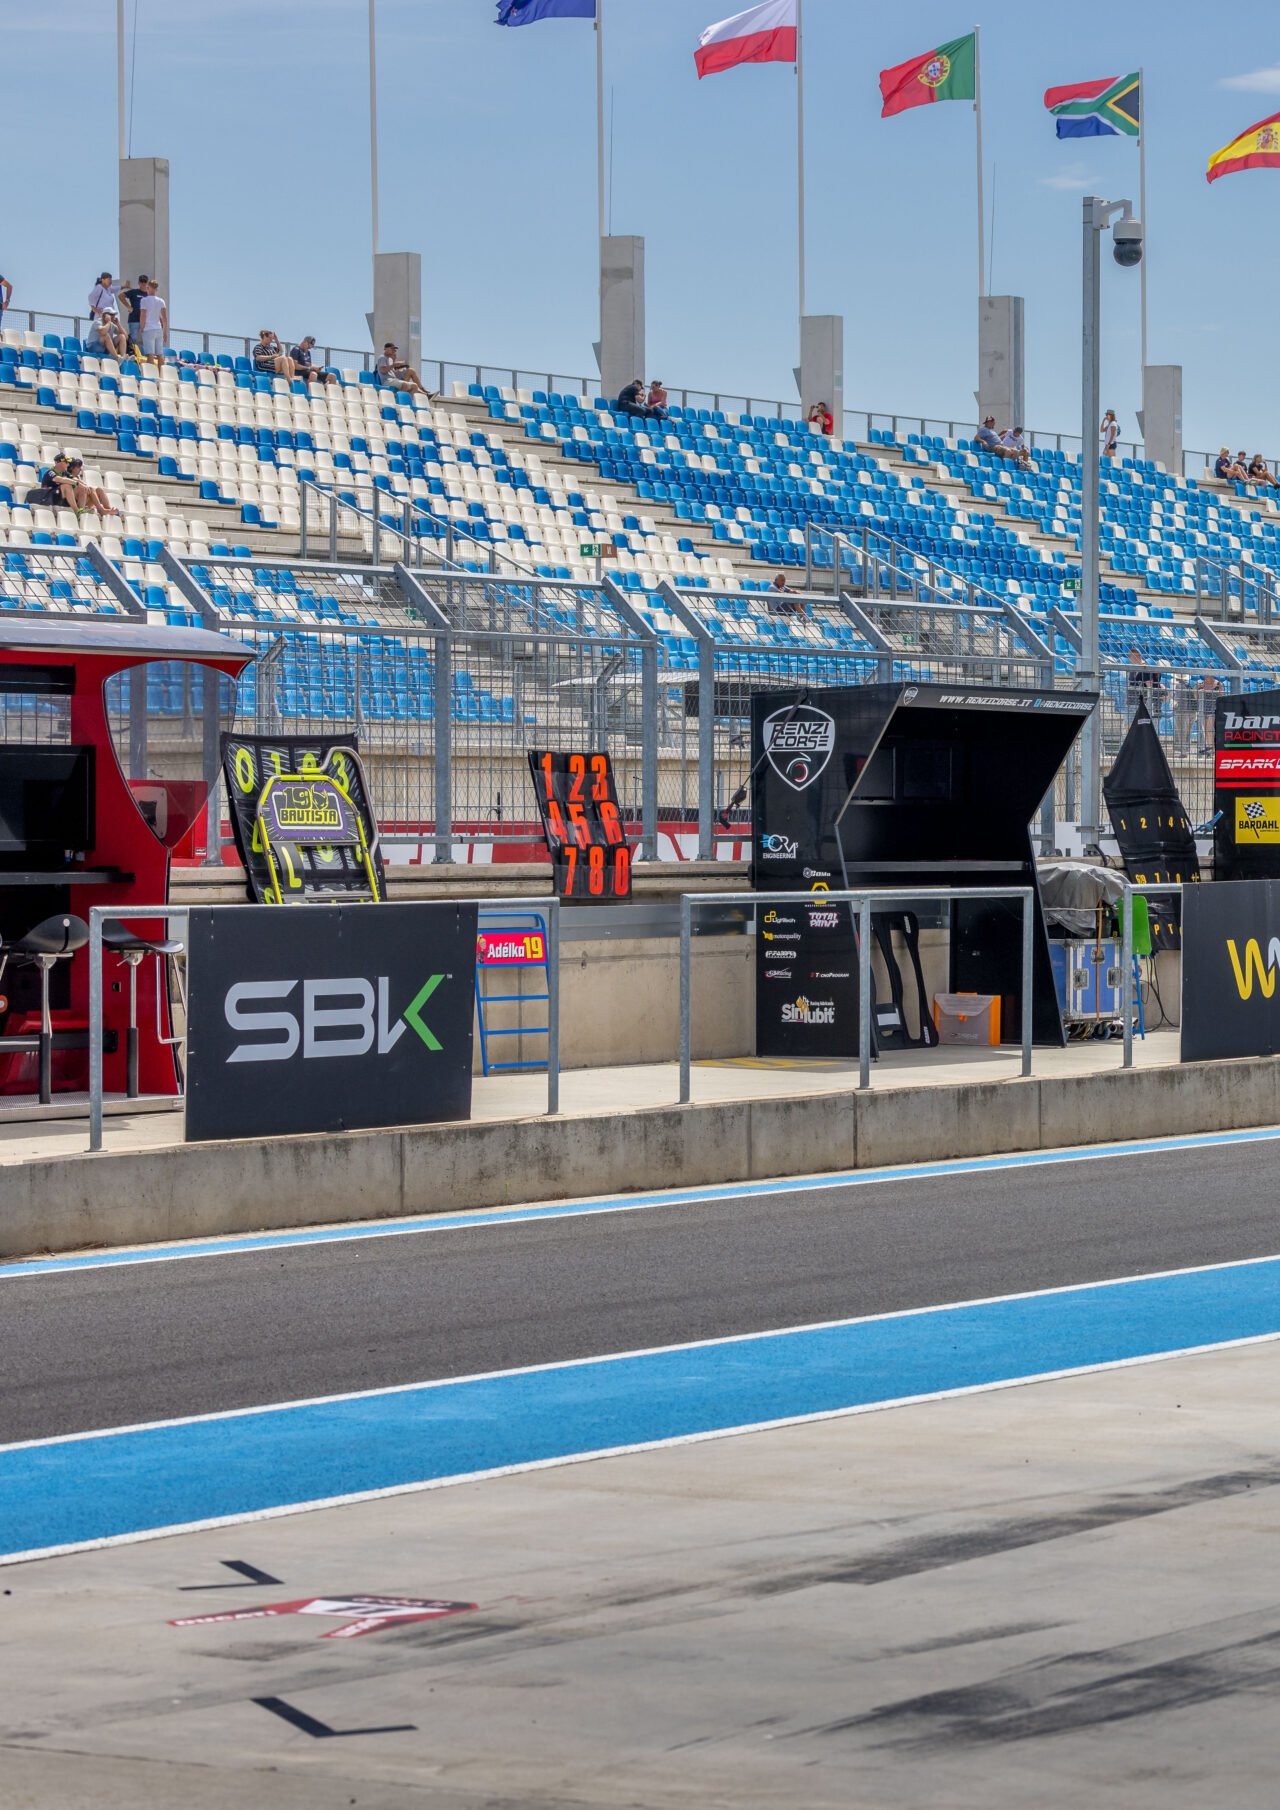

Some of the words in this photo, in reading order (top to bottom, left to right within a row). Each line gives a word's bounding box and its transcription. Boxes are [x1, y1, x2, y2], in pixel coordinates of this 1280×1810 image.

[771, 723, 829, 735] RENZI
[772, 735, 829, 750] CORSE
[1219, 758, 1276, 769] SPARK
[541, 753, 553, 799] 1
[569, 755, 585, 801] 2
[591, 755, 608, 800] 3
[279, 809, 338, 824] BAUTISTA
[1140, 817, 1147, 829] 2
[548, 801, 568, 844] 4
[568, 804, 592, 850] 5
[600, 802, 623, 844] 6
[1239, 820, 1279, 830] BARDAHL
[564, 847, 577, 895] 7
[589, 846, 604, 894] 8
[615, 848, 629, 895] 0
[808, 912, 837, 920] TOTAL
[523, 936, 543, 958] 19
[224, 974, 446, 1063] SBK
[174, 1611, 277, 1626] DUCATI
